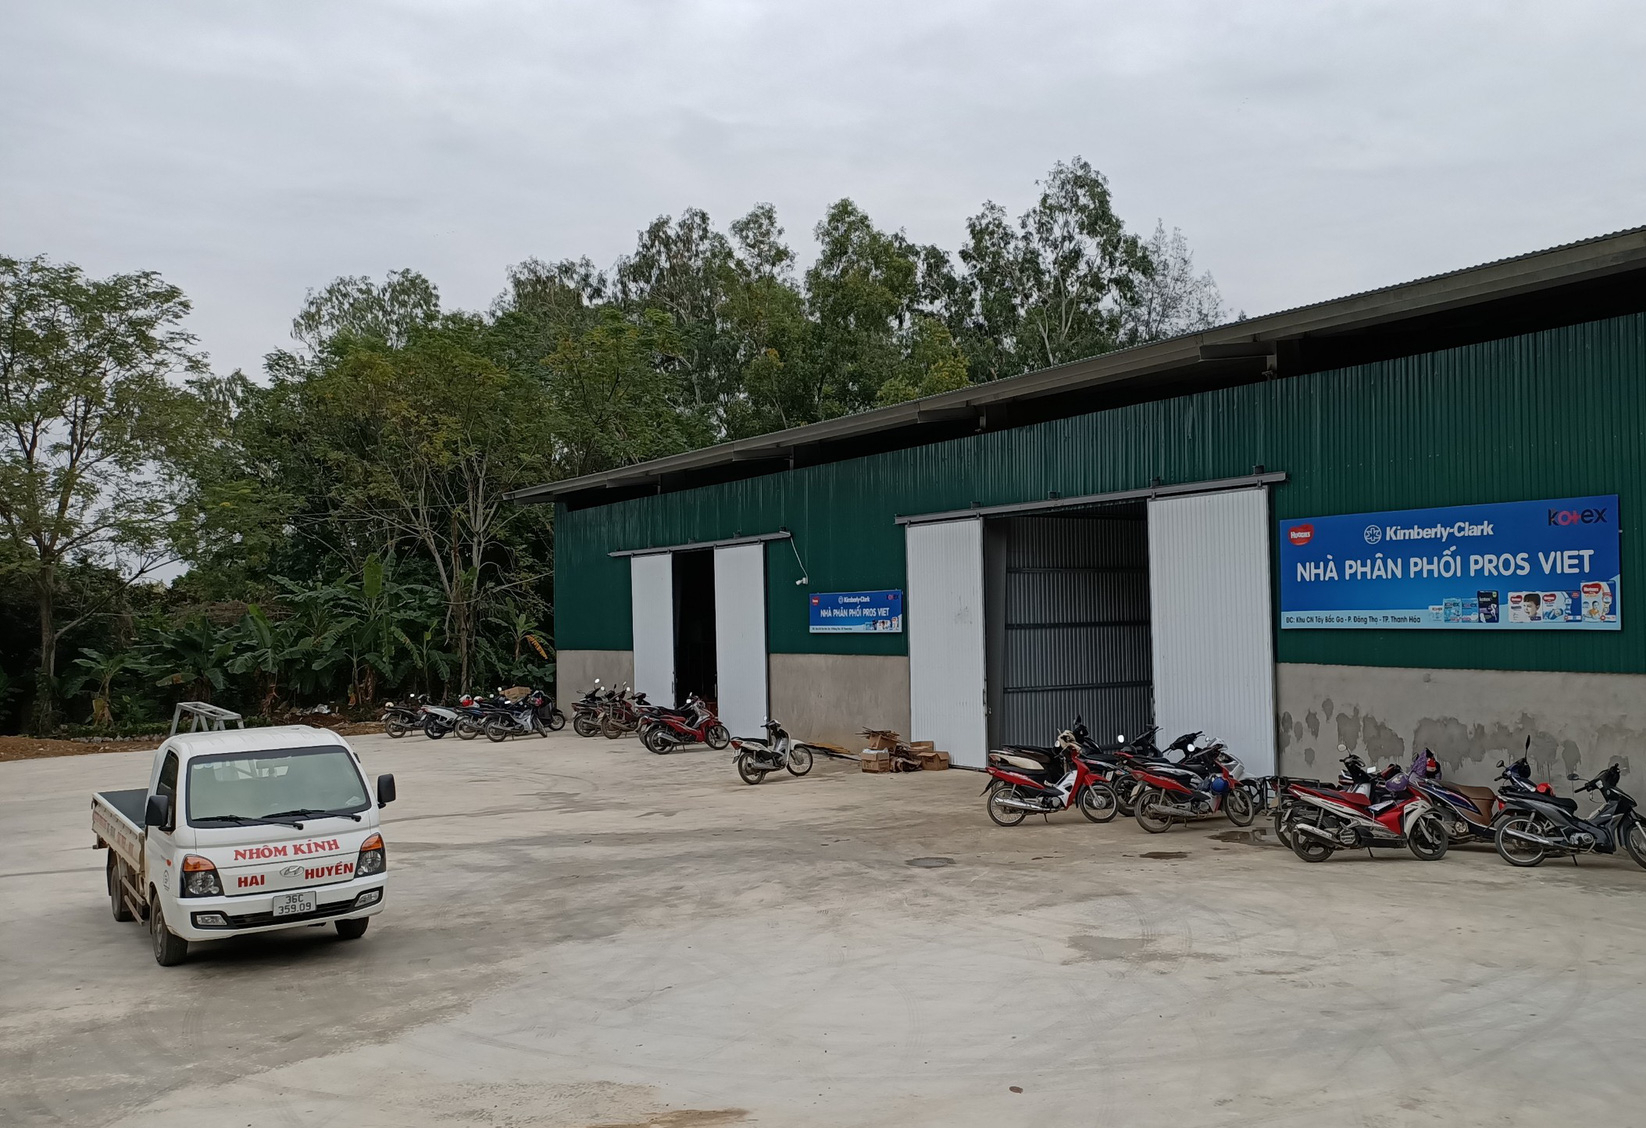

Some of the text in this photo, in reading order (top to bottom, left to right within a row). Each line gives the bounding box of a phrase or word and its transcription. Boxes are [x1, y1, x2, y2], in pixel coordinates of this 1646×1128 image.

[1385, 520, 1494, 542] Kimberly-Clark
[1296, 545, 1595, 582] NHÀ PHÂN PHỐI PROS VIET
[820, 606, 832, 618] NHÀ
[832, 606, 848, 617] PHÂN
[862, 608, 877, 617] PROS
[877, 607, 890, 617] VIET
[1391, 615, 1408, 623] Thanh
[233, 839, 340, 861] NHÔM KÍNH
[237, 874, 265, 888] HAI
[285, 894, 304, 905] 36C
[278, 902, 312, 915] 359.09
